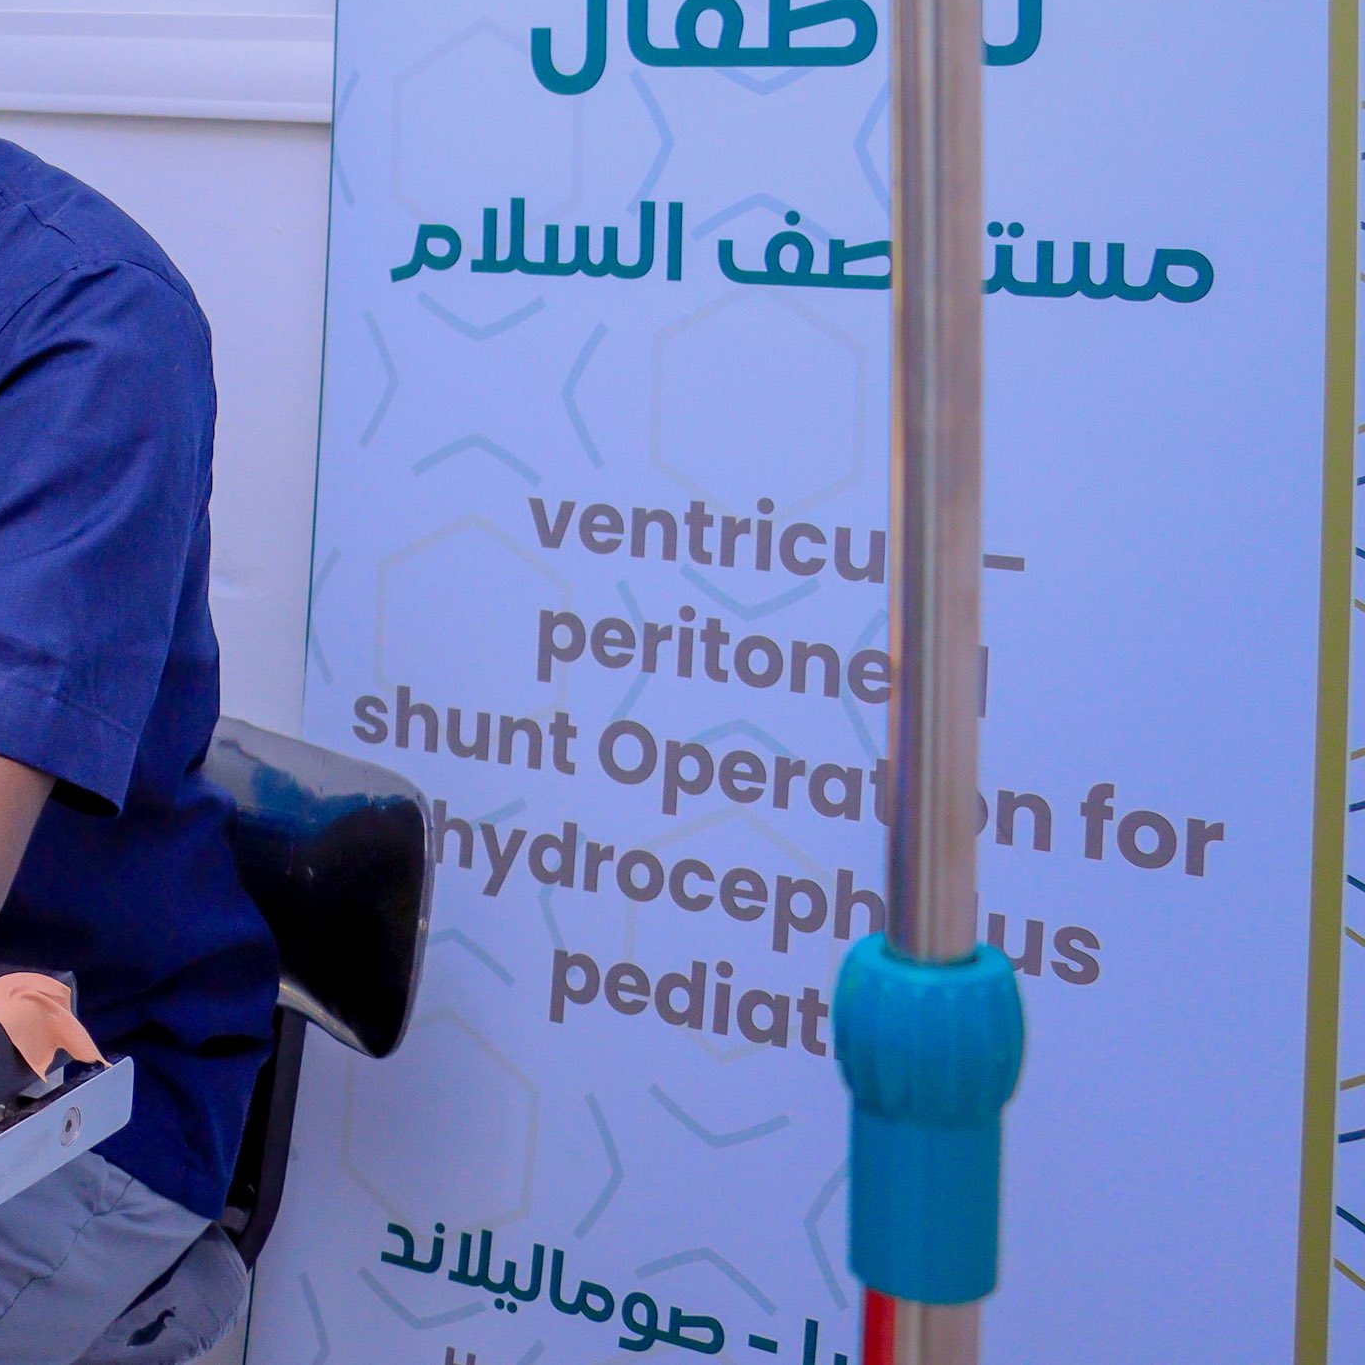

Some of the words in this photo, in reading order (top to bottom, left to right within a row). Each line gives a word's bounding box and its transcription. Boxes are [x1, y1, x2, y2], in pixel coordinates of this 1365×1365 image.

[390, 197, 684, 283] السلام
[718, 209, 1215, 304] مستصف
[536, 604, 989, 719] peritonel
[352, 685, 578, 777] shunt
[598, 718, 1052, 853] Operatn
[1080, 782, 1225, 878] for
[432, 798, 1101, 986] hydrocephus
[549, 943, 837, 1060] pediat
[380, 1221, 726, 1356] صوماليلاند
